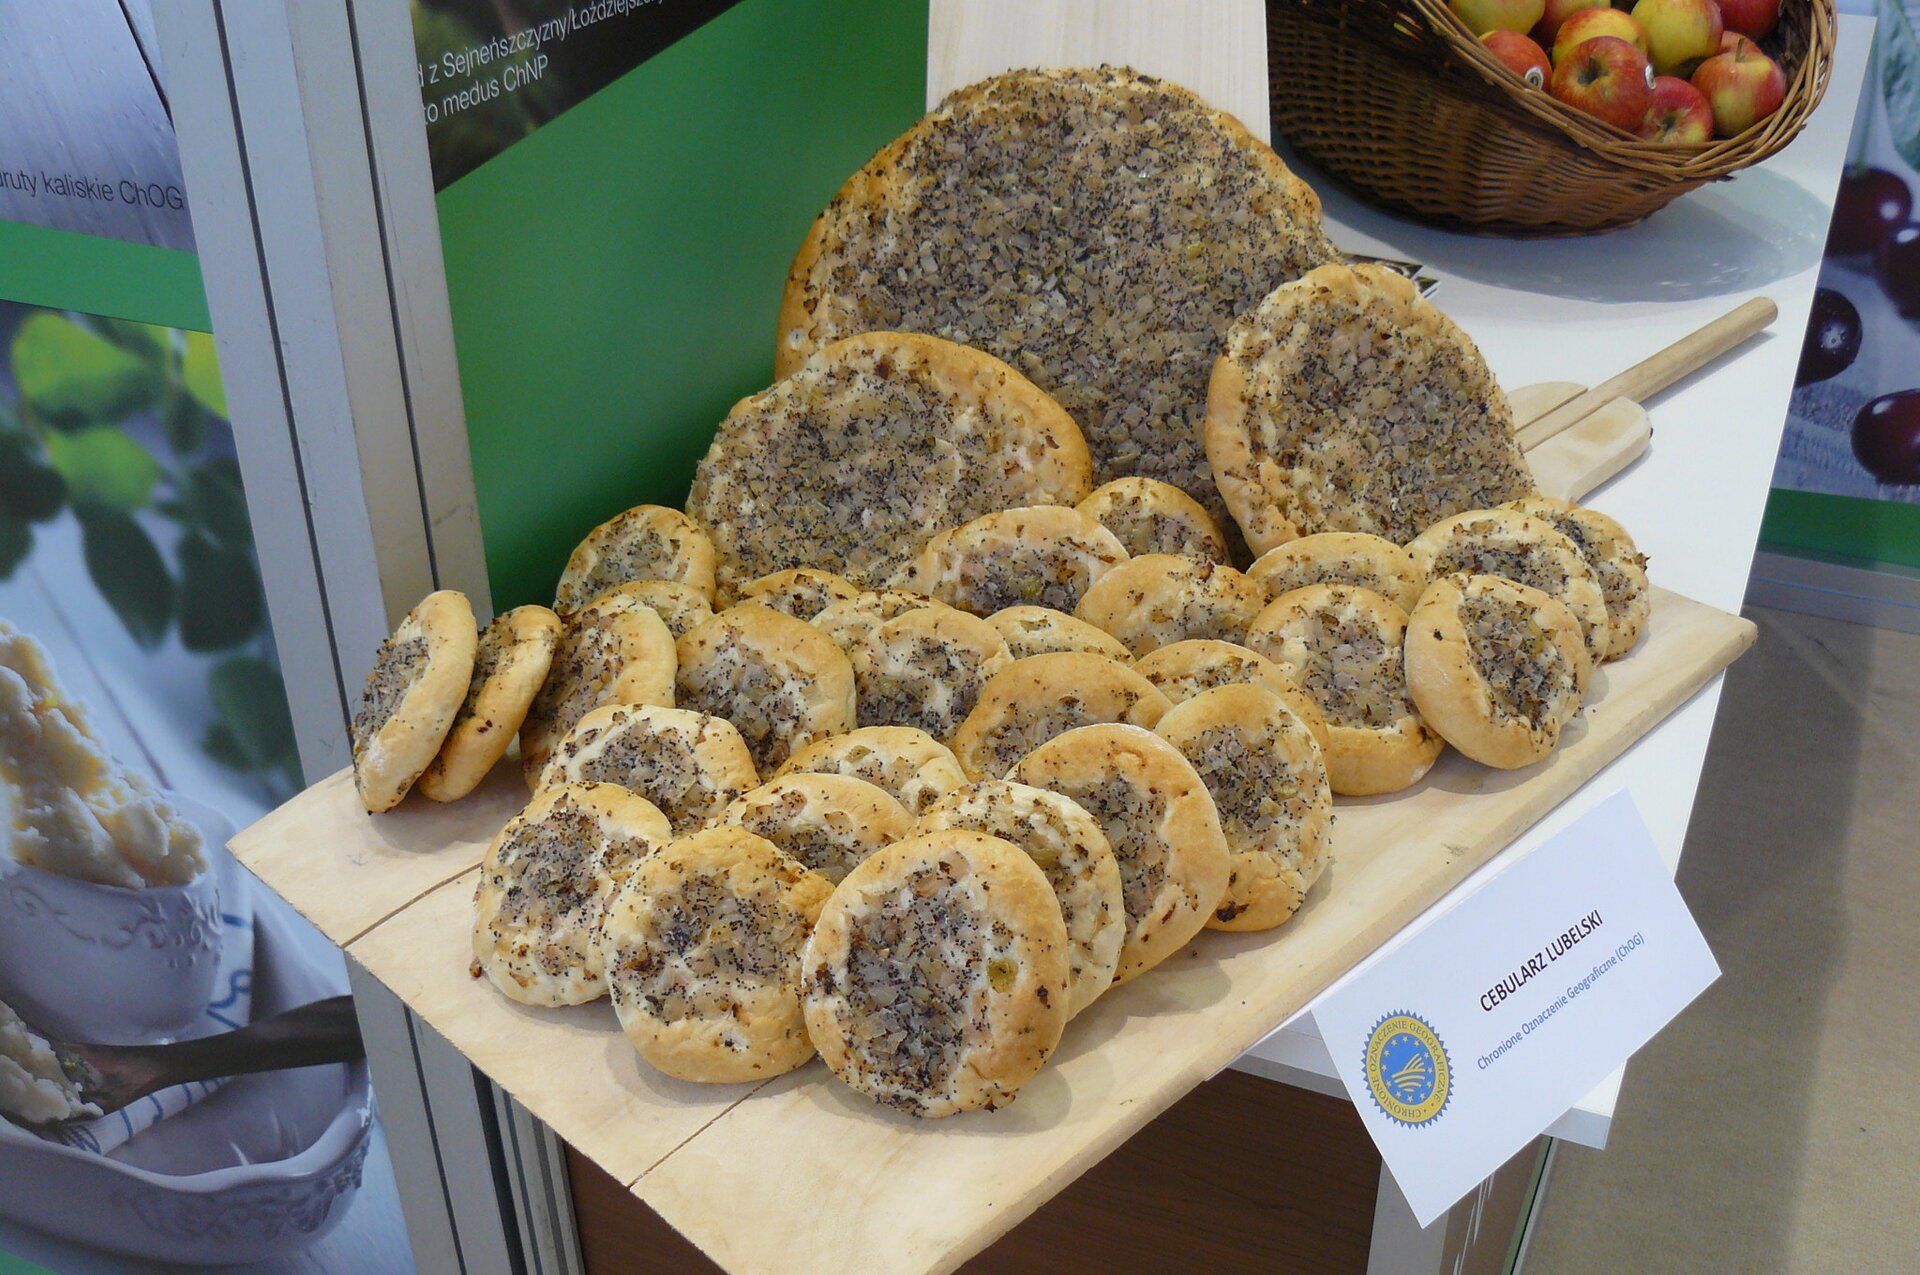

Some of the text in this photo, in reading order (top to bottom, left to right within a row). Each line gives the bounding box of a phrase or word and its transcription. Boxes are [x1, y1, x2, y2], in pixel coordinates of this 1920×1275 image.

[429, 64, 440, 84] z
[443, 78, 500, 117] medus
[503, 54, 549, 93] ChNP
[41, 170, 114, 202] kaliskie
[119, 180, 185, 210] ChOG
[1477, 931, 1645, 1070] Chronione Oznaczenie Geograficzne (ChOG)
[1480, 909, 1603, 1012] CEBULARZ LUBELSKI
[1369, 1020, 1446, 1118] CHRONIONE OZNACZENIE GEOGRAFICZNE
